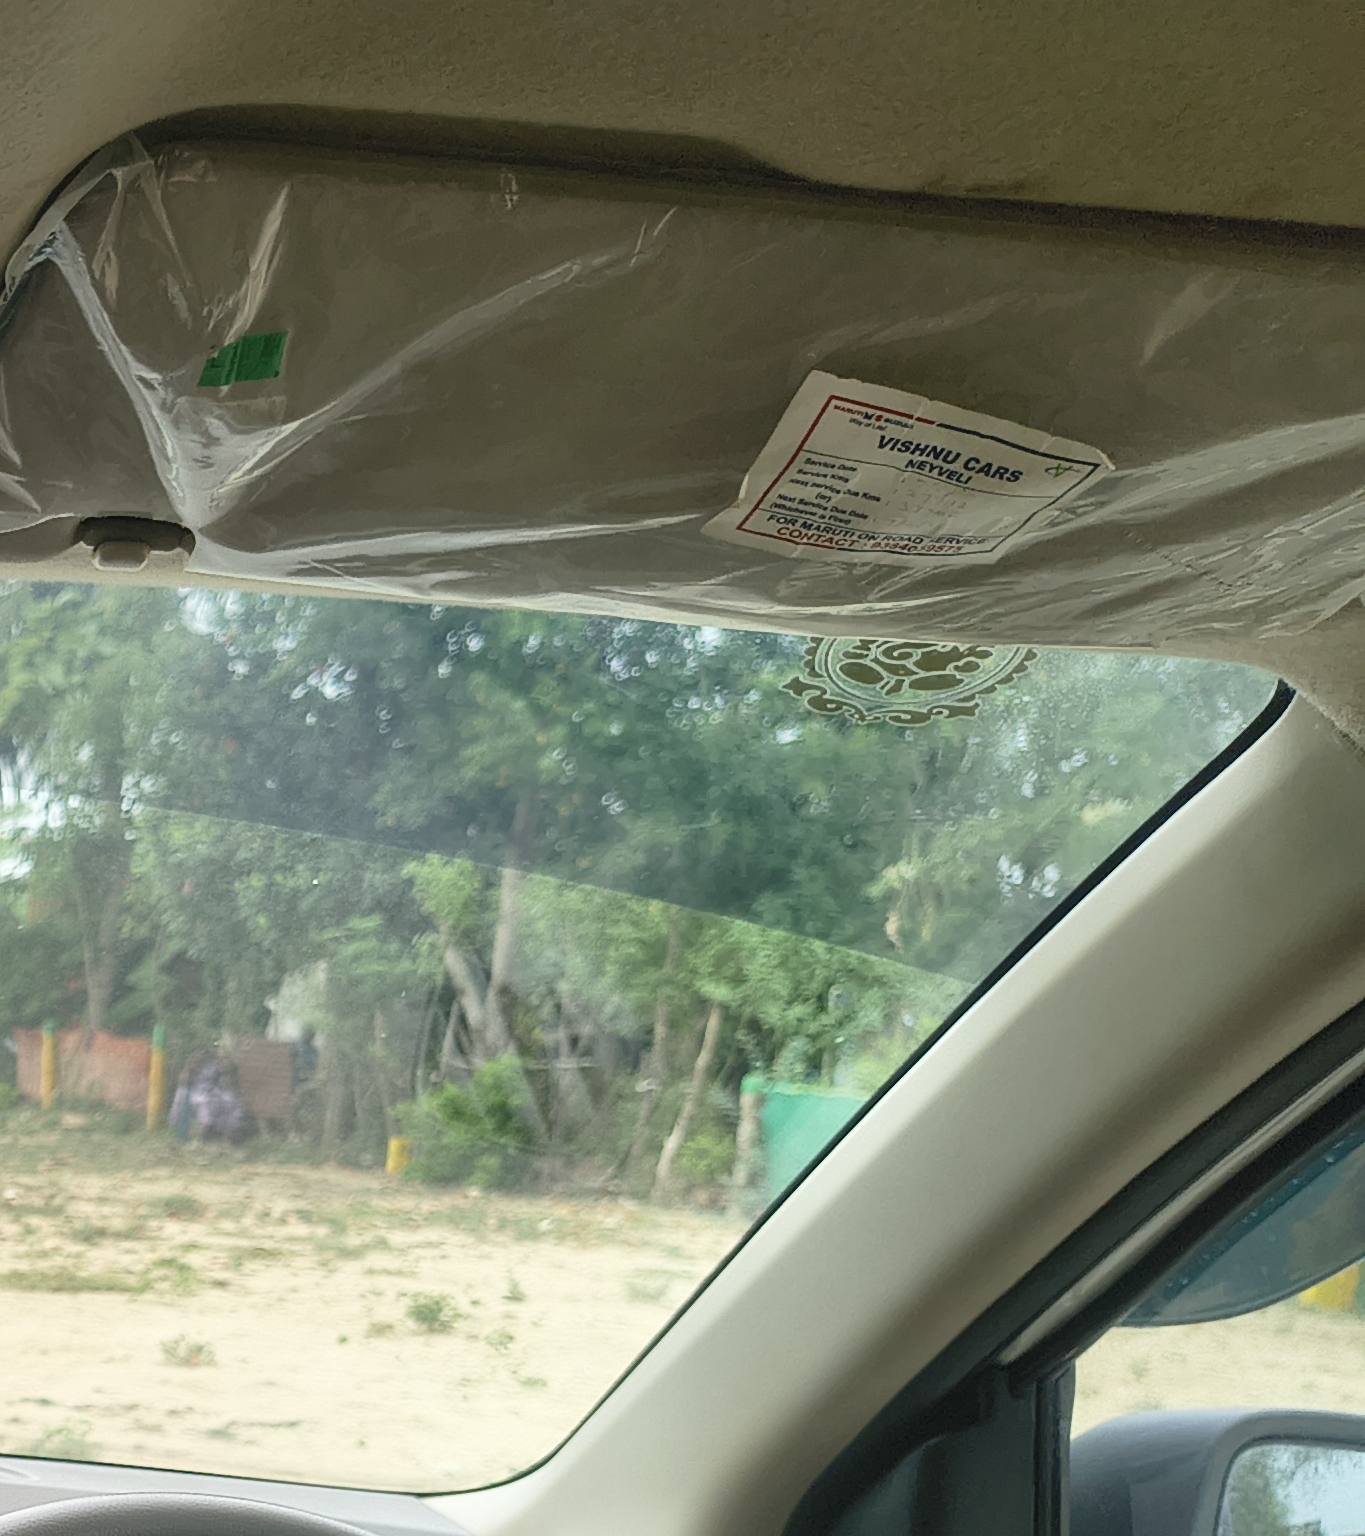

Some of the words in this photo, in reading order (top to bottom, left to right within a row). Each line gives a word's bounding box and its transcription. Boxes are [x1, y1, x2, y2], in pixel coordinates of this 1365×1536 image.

[877, 435, 962, 465] VISHNU
[963, 457, 1024, 484] CARS
[904, 459, 973, 485] NEYVELI
[767, 514, 799, 527] FOR
[800, 520, 856, 539] MARUTI
[857, 532, 880, 541] ON
[882, 535, 924, 545] ROAD
[777, 526, 859, 547] CONTACT
